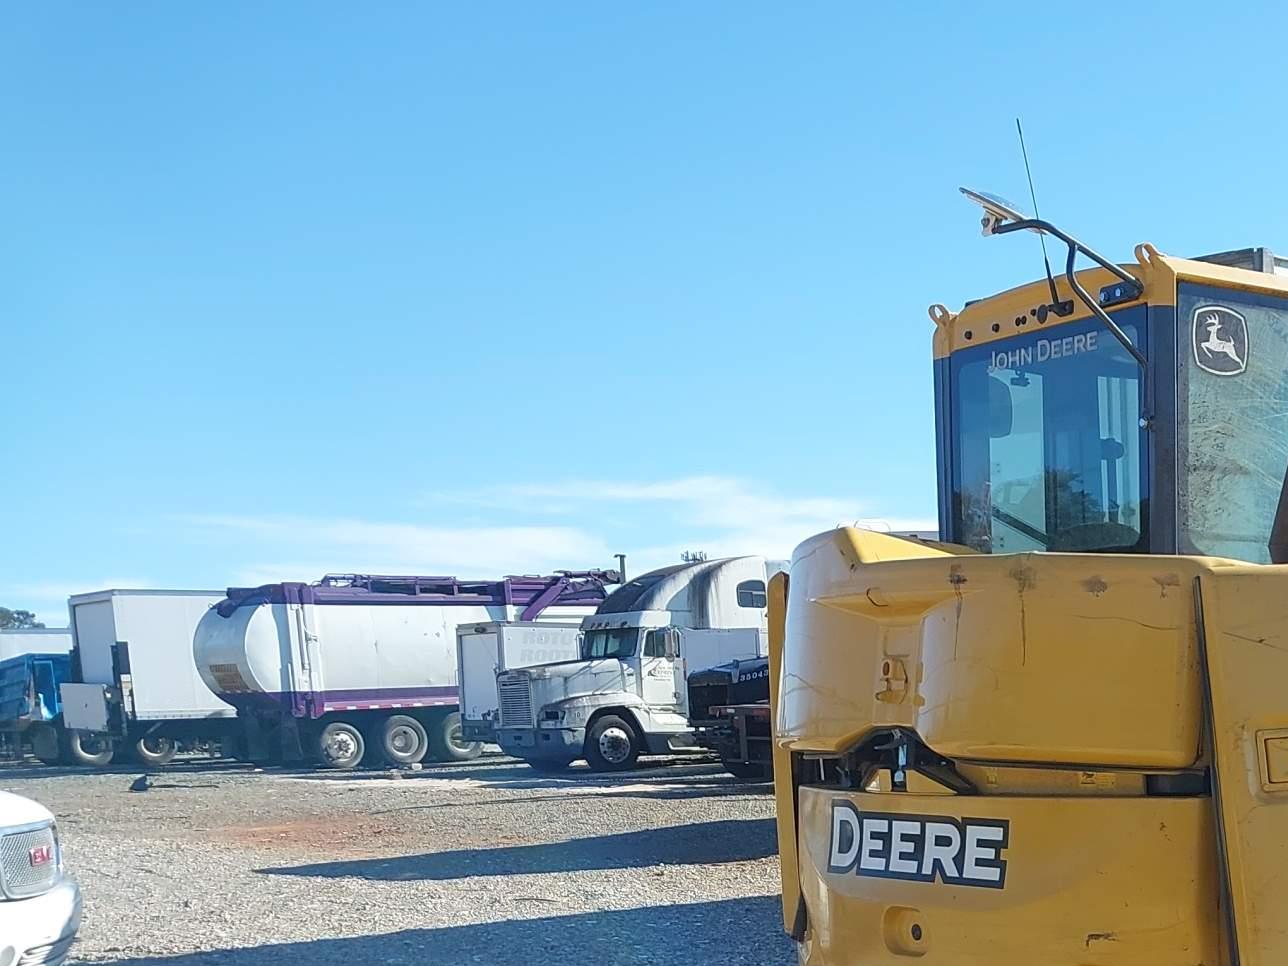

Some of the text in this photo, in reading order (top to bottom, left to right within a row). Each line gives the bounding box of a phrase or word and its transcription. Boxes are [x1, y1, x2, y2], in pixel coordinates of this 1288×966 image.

[988, 331, 1098, 371] JOHN DEERE
[830, 806, 1004, 882] DEERE
